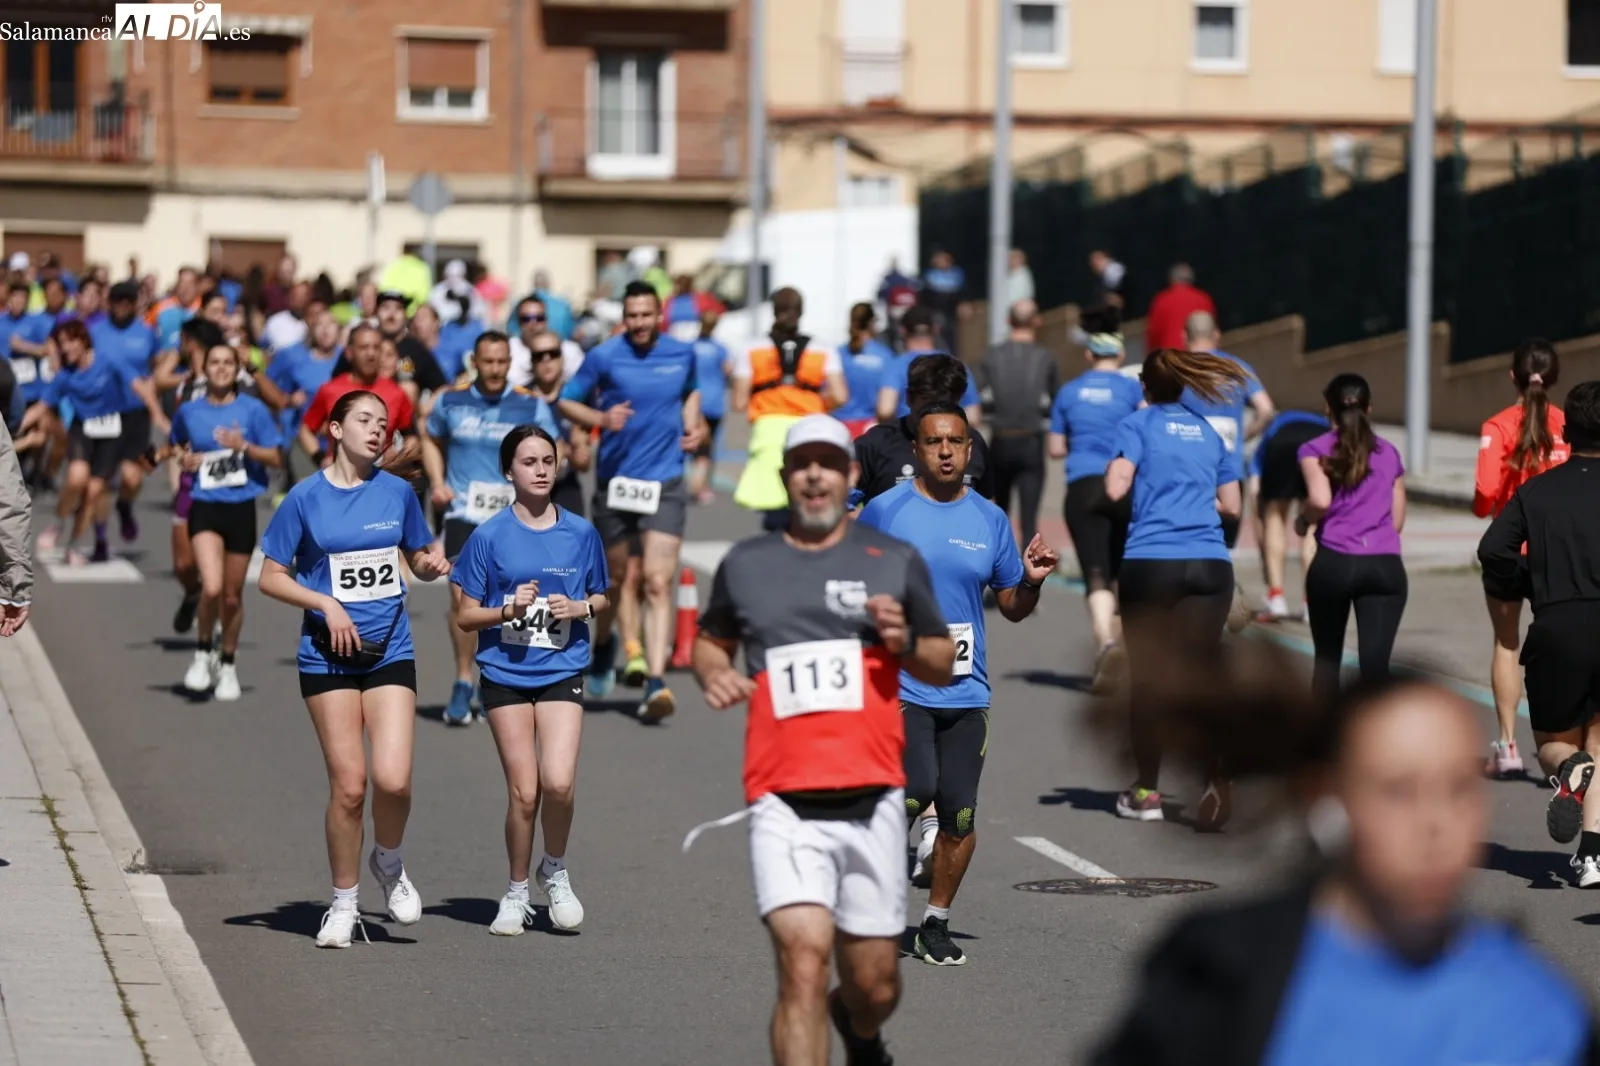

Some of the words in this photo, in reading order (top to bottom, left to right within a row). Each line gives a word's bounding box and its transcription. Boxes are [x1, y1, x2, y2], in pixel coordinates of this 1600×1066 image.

[616, 483, 653, 501] 530
[474, 493, 510, 510] 529
[949, 538, 971, 546] CASTILLA
[362, 549, 395, 559] COMUNIDAD
[339, 563, 394, 590] 592
[955, 639, 969, 662] 2
[782, 656, 849, 694] 113
